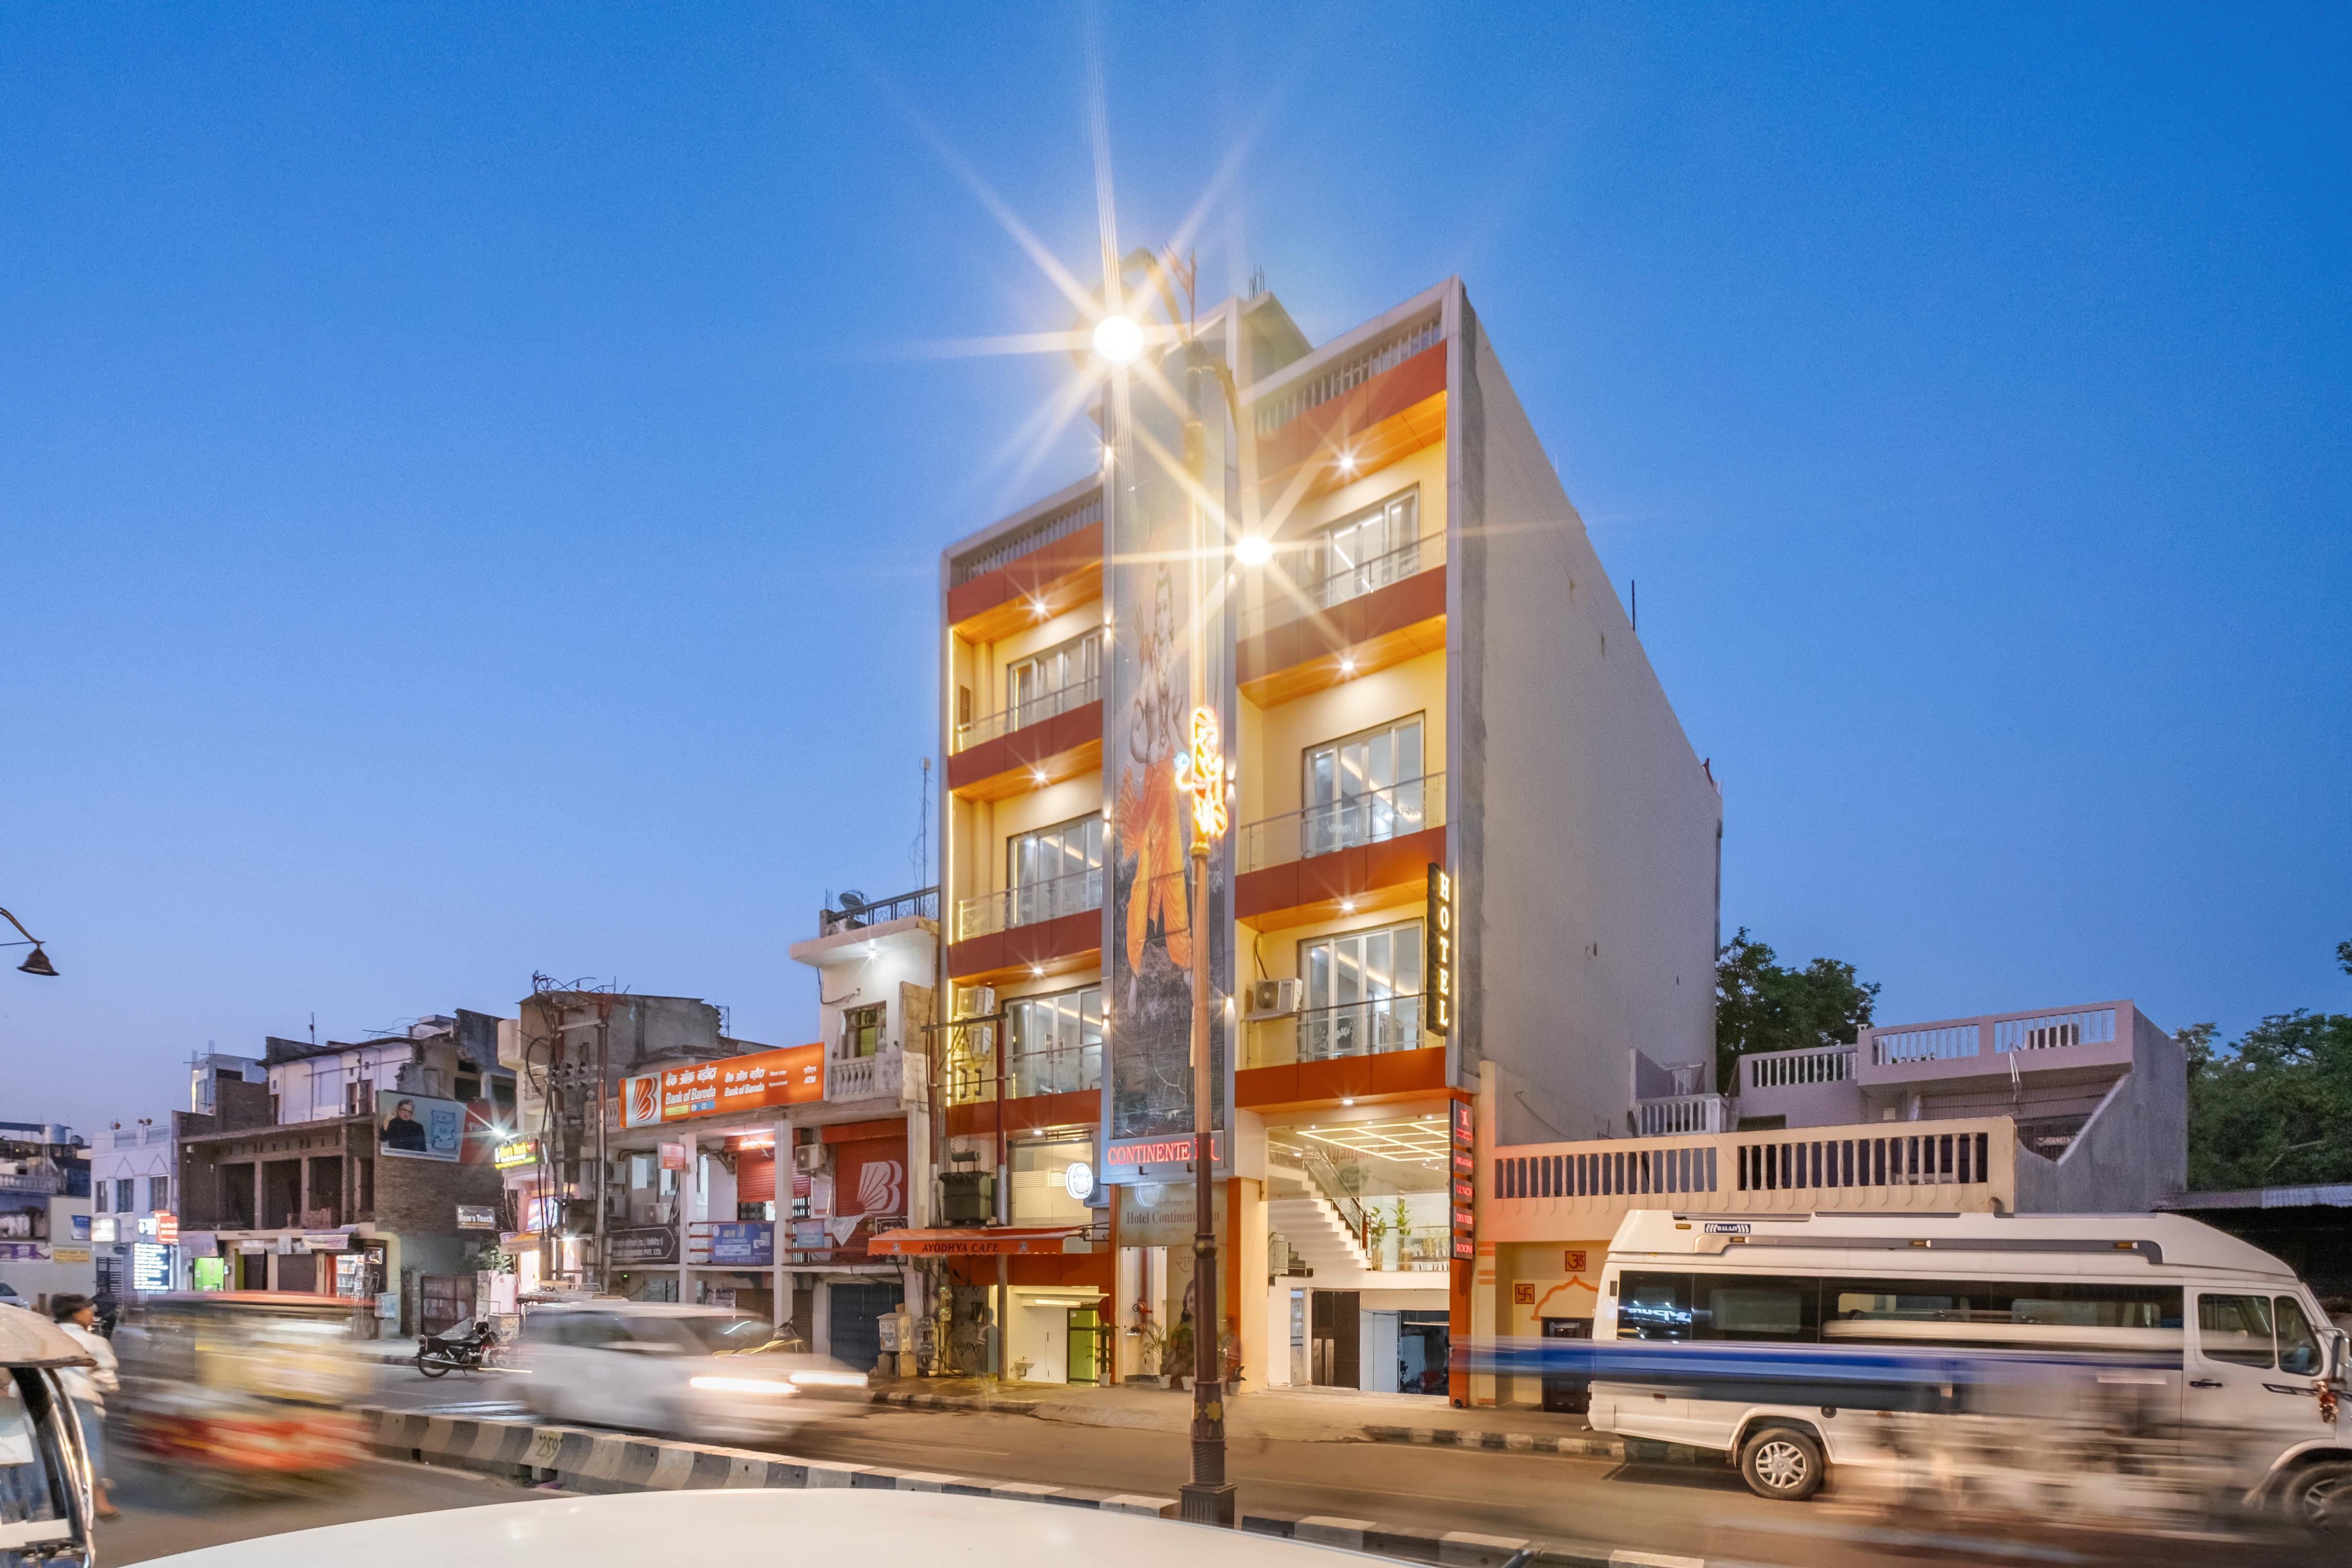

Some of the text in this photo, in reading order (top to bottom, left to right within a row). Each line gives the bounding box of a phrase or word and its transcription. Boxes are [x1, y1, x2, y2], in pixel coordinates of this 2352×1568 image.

[1439, 871, 1450, 1027] HOTEL
[804, 1076, 816, 1084] ATM
[665, 1085, 717, 1105] Bank of Baroda
[724, 1086, 739, 1097] Bank
[738, 1085, 745, 1095] of
[745, 1081, 765, 1094] Baroda
[1126, 1212, 1149, 1224] Hotel
[1152, 1210, 1196, 1224] Continent
[922, 1242, 999, 1253] AYODHYA CAFE
